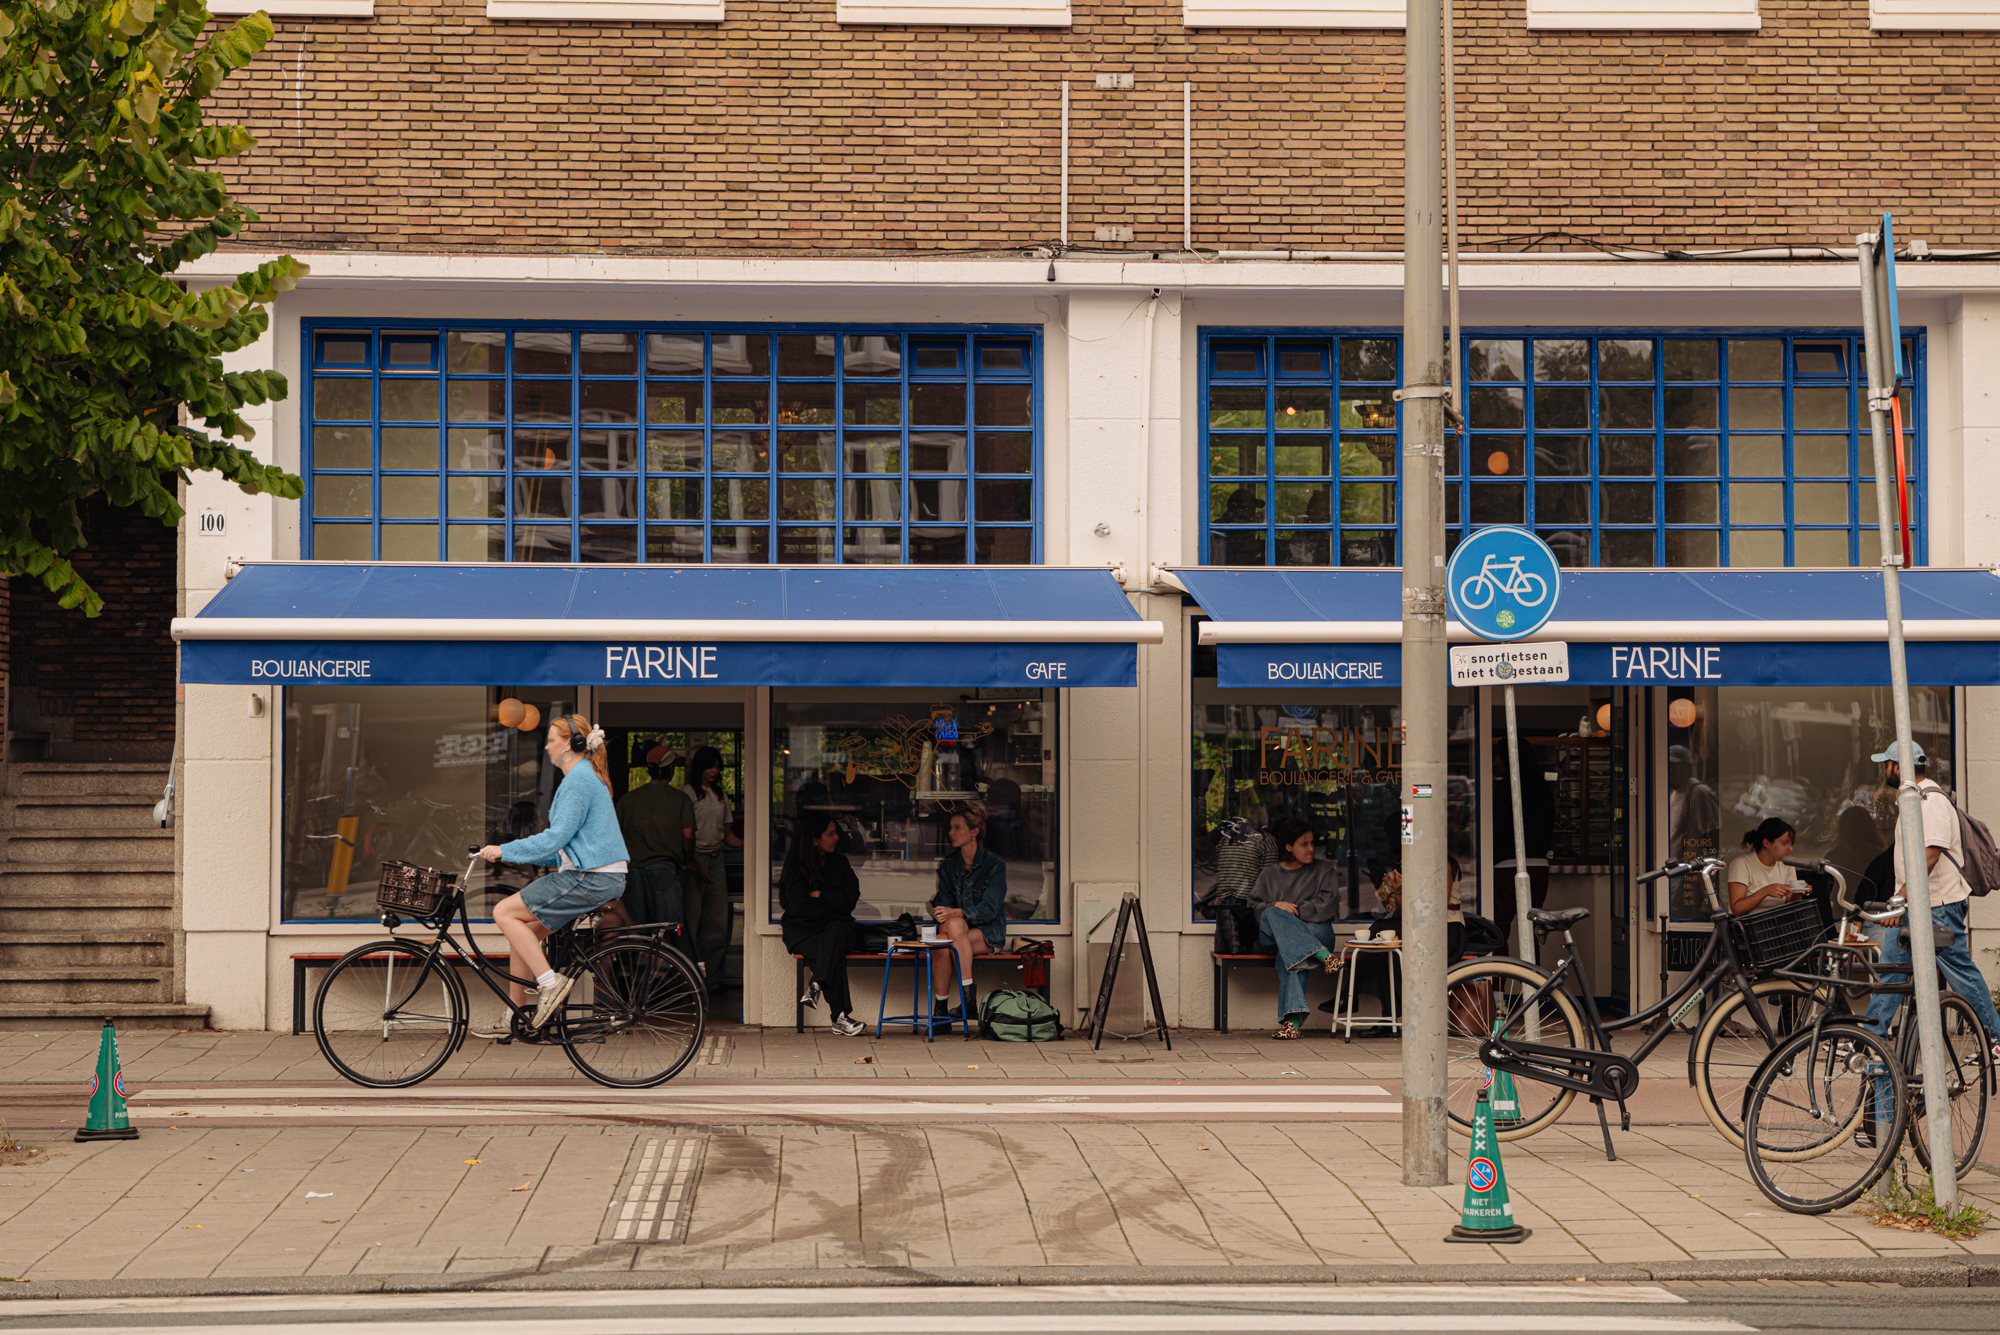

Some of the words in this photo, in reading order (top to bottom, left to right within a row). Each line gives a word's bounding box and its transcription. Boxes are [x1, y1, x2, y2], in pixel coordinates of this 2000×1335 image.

[200, 514, 225, 531] 100
[605, 646, 718, 679] FARINE
[1471, 652, 1547, 663] snorfietsen
[1611, 646, 1722, 679] FARINE
[251, 660, 371, 677] BOULANGERIE
[1025, 662, 1067, 679] CAFE
[1267, 662, 1383, 680] BOULANGERIE
[1458, 668, 1484, 678] niet
[1489, 665, 1562, 678] tgestaan
[1260, 727, 1402, 769] FARINE
[1260, 770, 1358, 786] BOULANGERIE
[1361, 771, 1373, 786] &
[1375, 770, 1402, 786] CAF
[1683, 838, 1713, 847] HOURS
[1671, 937, 1727, 965] ENTRA
[1672, 991, 1703, 1023] BATAVUS
[1471, 1198, 1489, 1206] NIET
[1463, 1207, 1501, 1216] PARKEREN
